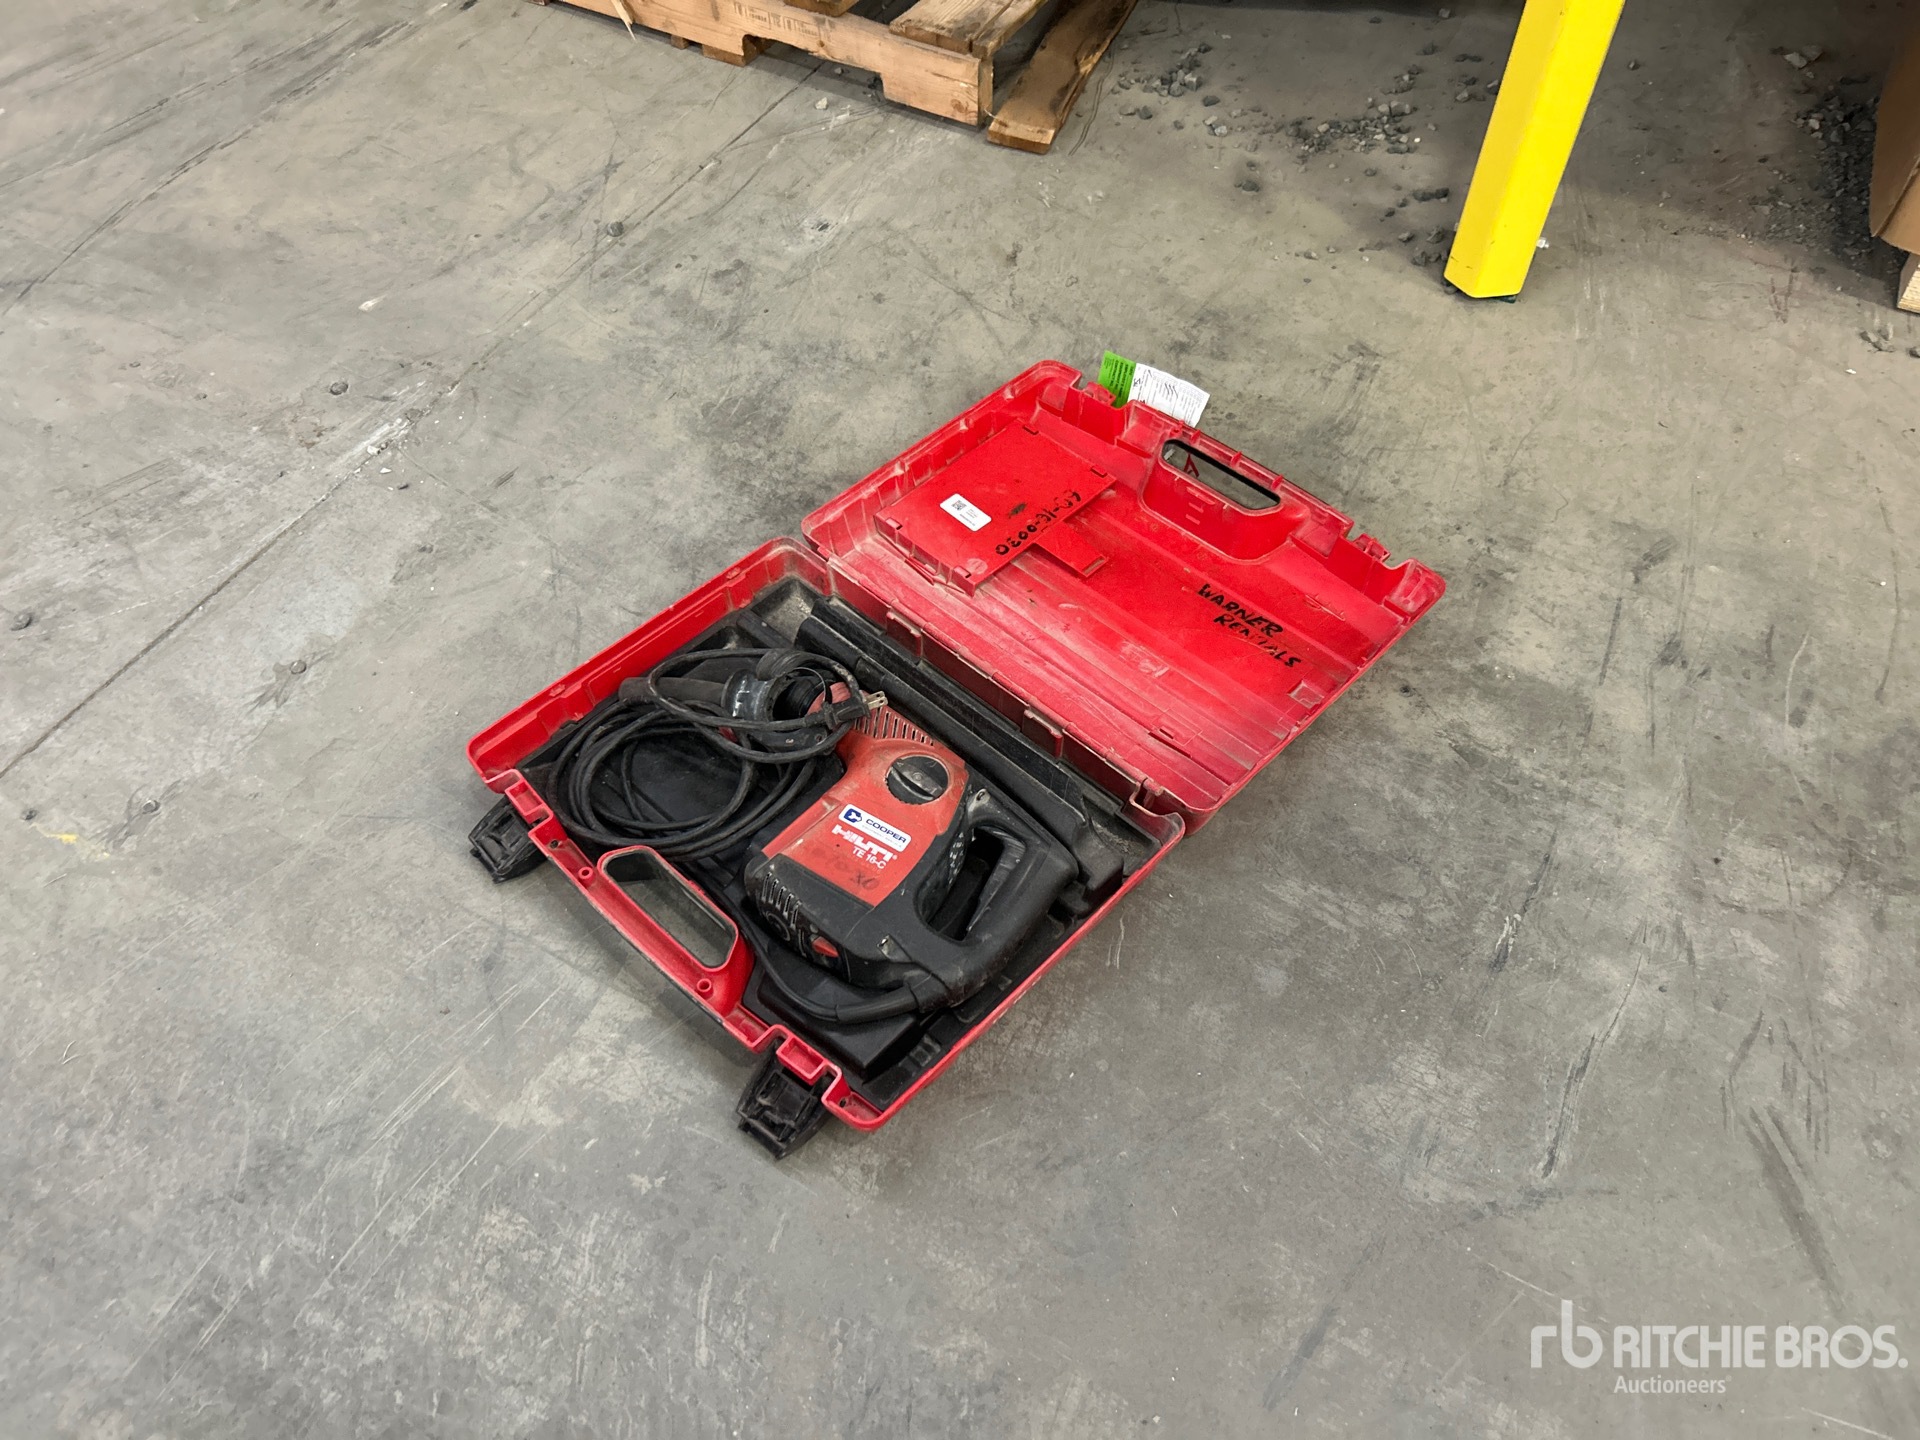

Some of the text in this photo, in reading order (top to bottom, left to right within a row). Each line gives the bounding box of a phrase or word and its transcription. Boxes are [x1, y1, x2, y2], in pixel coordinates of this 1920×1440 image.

[1197, 583, 1284, 638] WARNER
[1213, 613, 1301, 668] RENTALS
[831, 824, 894, 862] HILTI
[865, 818, 907, 843] COOPER
[853, 846, 867, 859] TE
[866, 854, 887, 869] 16-C
